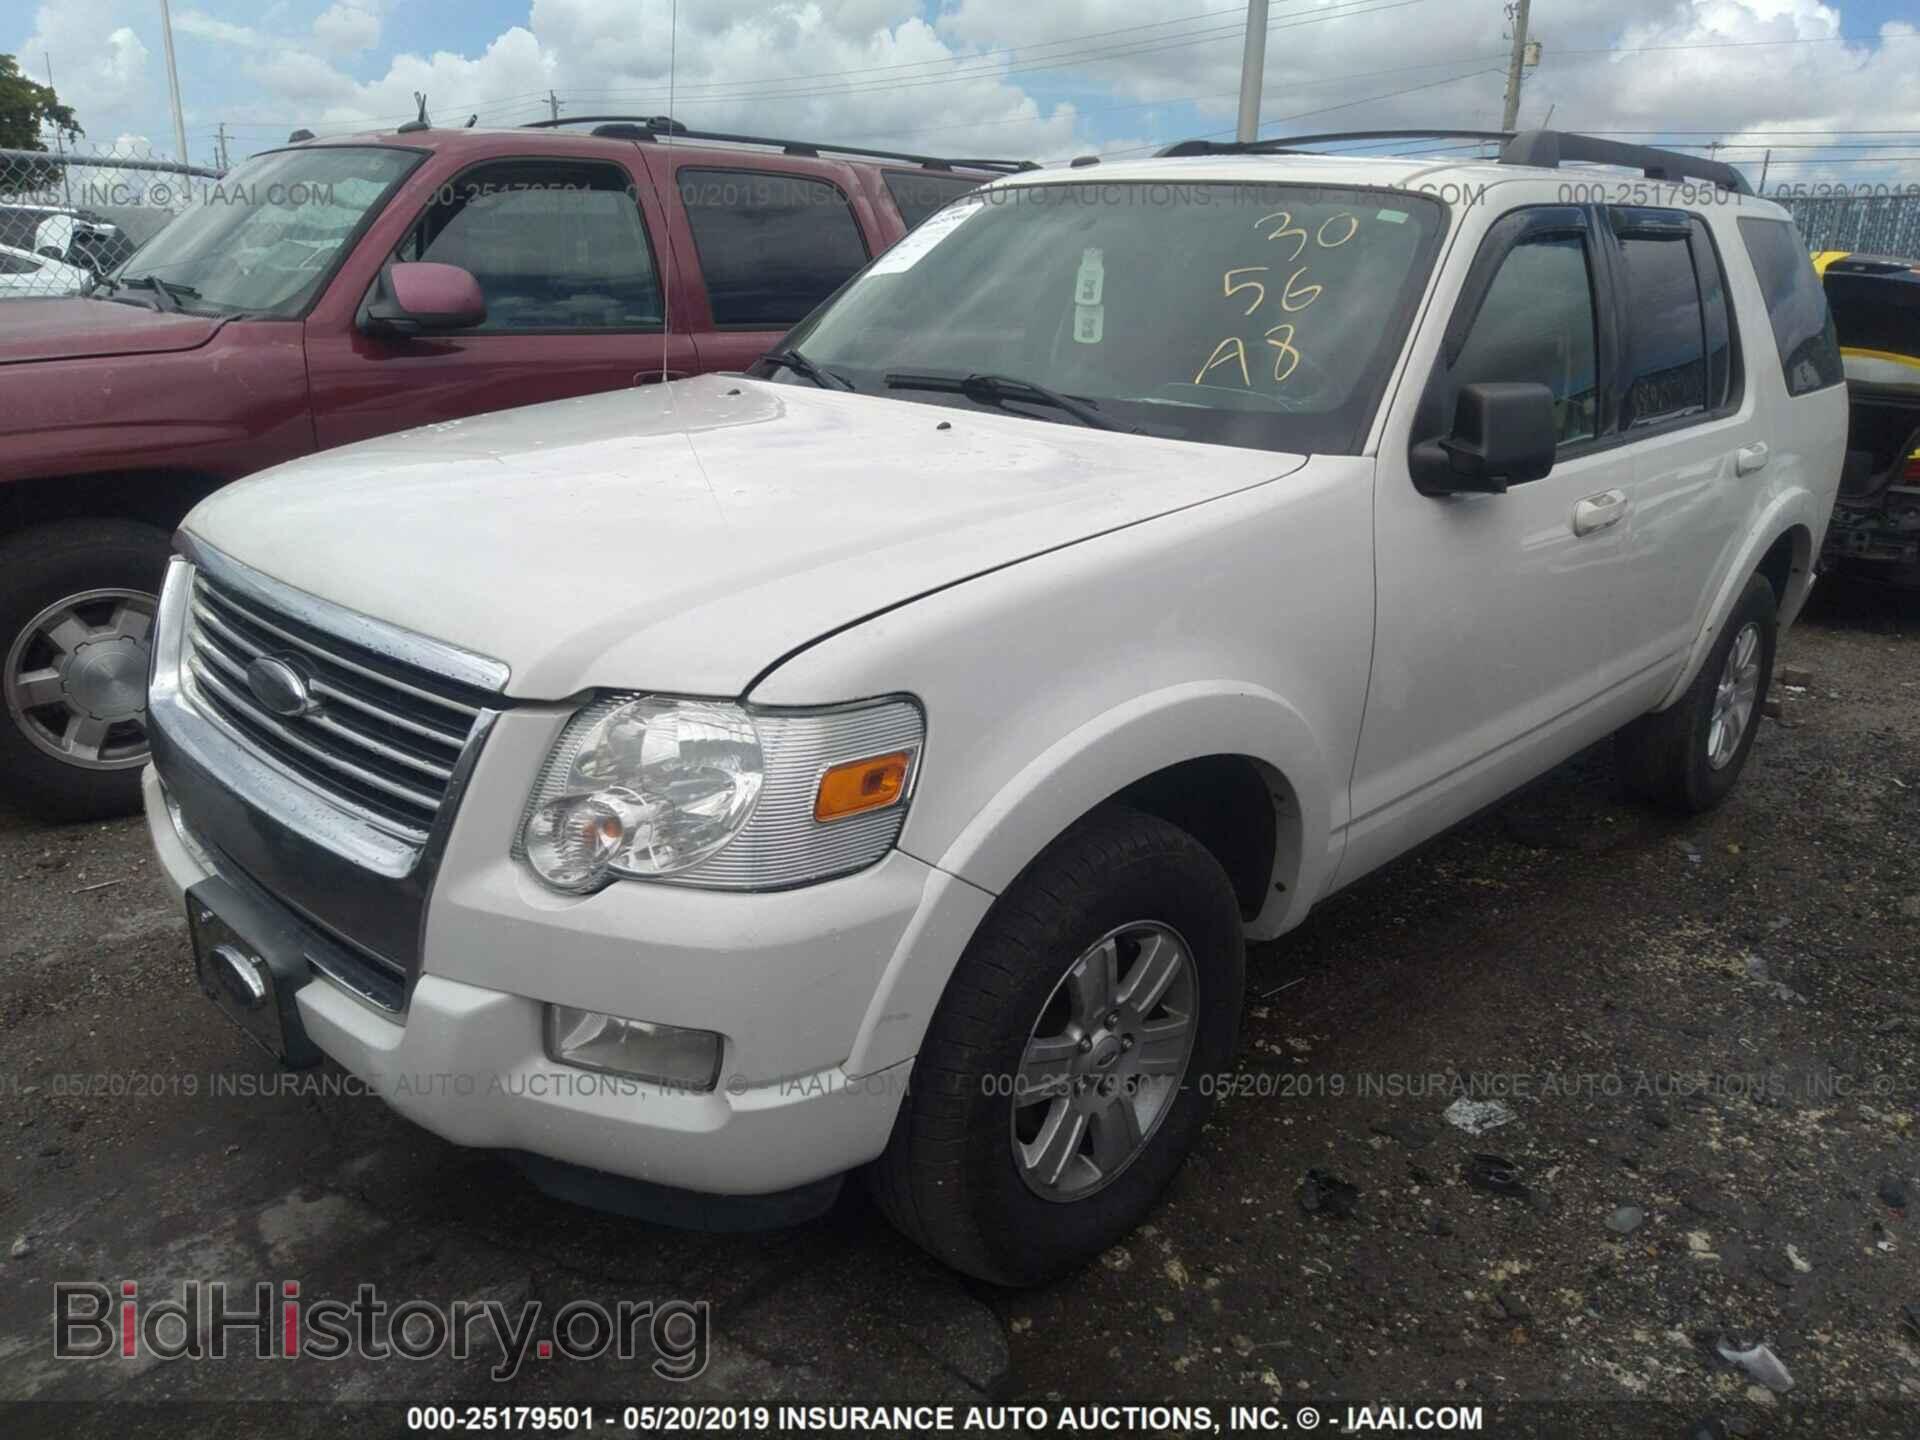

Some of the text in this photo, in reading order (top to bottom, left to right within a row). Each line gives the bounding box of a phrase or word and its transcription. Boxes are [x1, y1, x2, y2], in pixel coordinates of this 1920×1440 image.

[1254, 211, 1359, 262] 30
[1224, 266, 1323, 315] 56
[1194, 323, 1301, 386] A8
